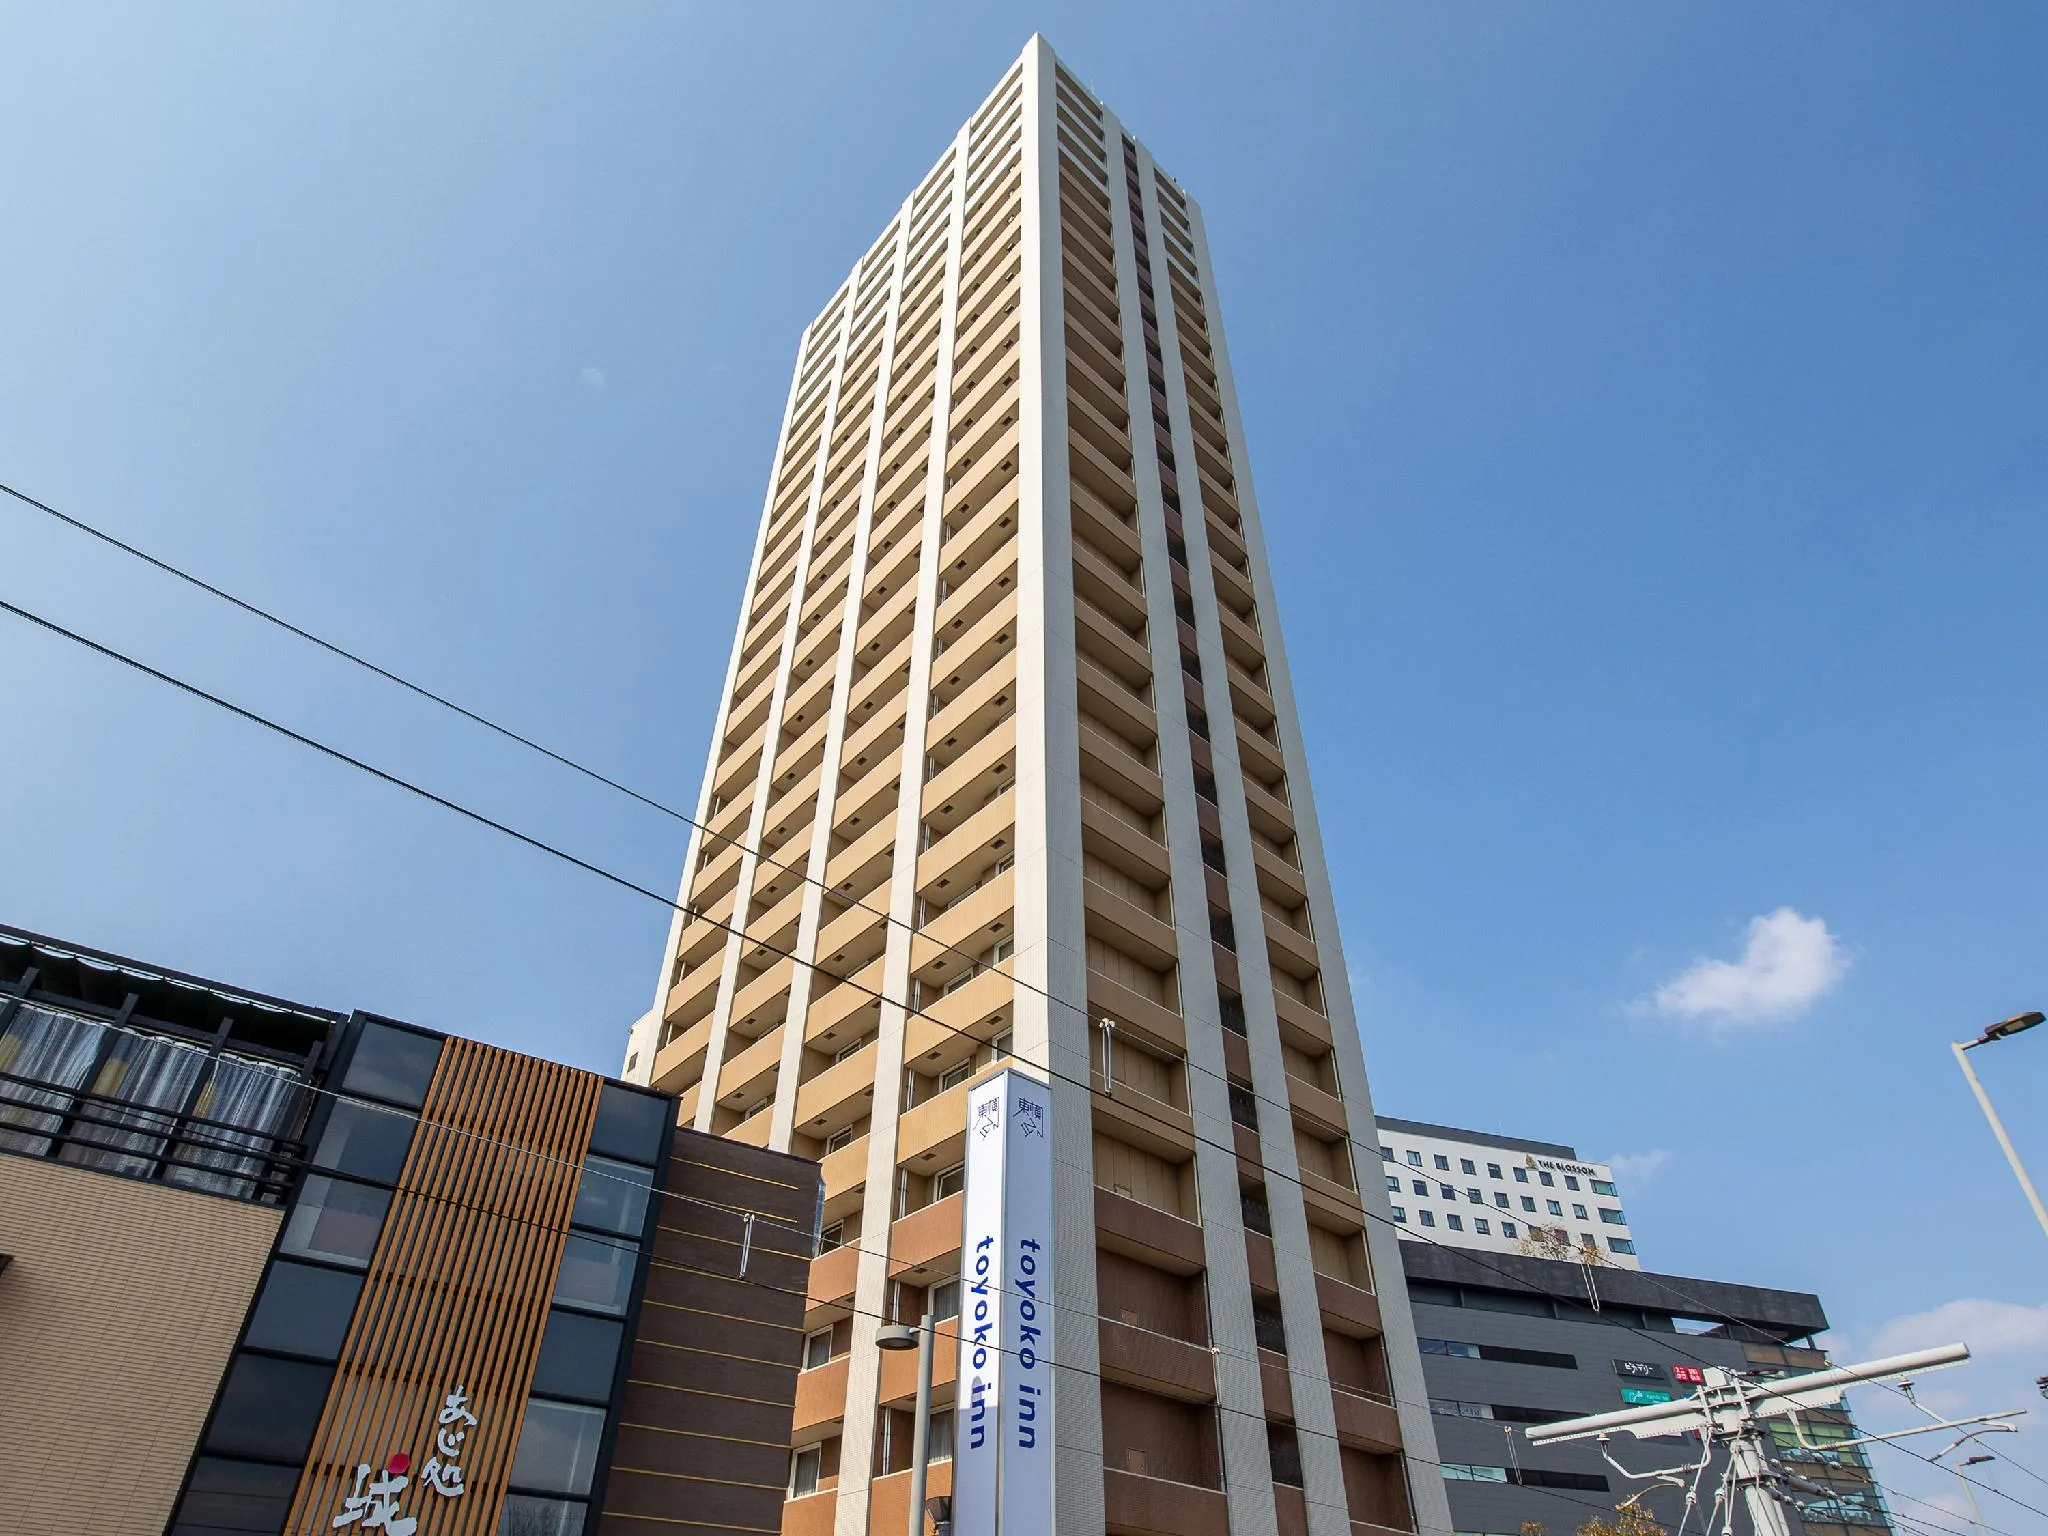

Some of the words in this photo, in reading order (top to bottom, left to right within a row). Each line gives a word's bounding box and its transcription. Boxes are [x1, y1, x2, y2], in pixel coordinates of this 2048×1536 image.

[1538, 1160, 1555, 1170] THE
[1555, 1163, 1594, 1175] BLOSSOM
[971, 1235, 994, 1370] toyoko
[1014, 1236, 1042, 1370] toyoko
[970, 1382, 992, 1450] inn
[1018, 1383, 1042, 1449] inn
